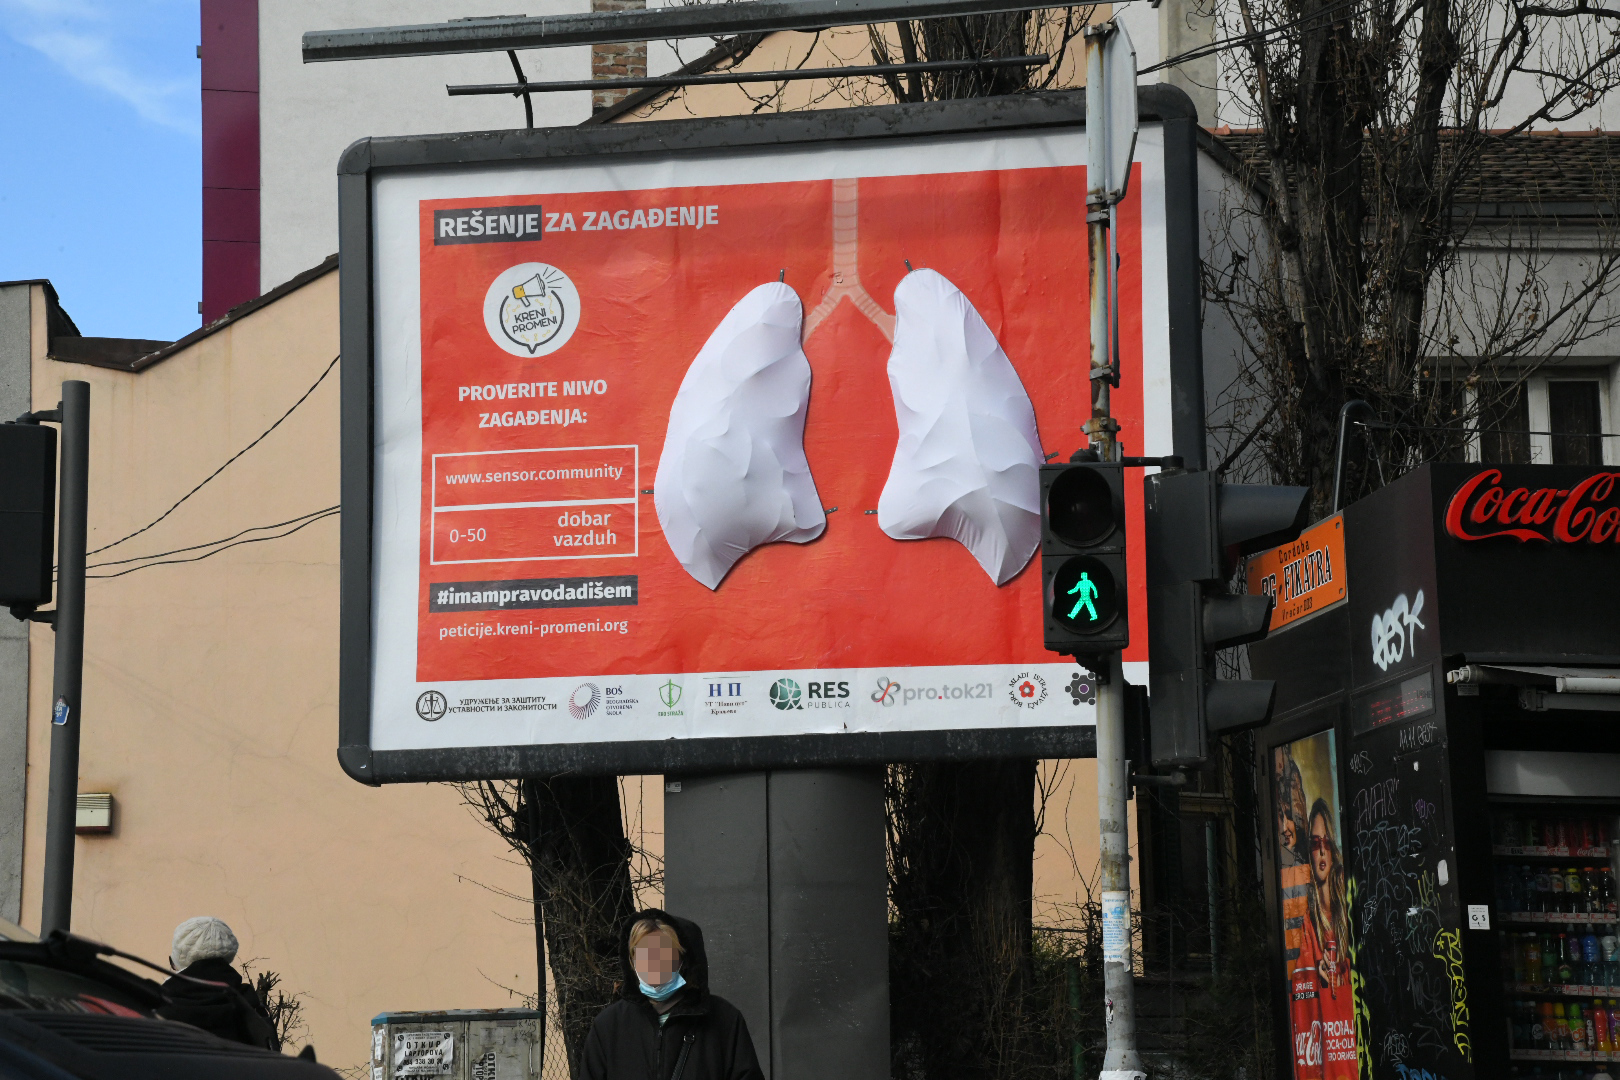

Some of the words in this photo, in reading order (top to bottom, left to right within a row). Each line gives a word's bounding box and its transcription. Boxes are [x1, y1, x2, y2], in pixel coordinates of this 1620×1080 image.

[439, 209, 539, 238] REŠENJE
[545, 212, 577, 232] ZA
[582, 205, 719, 230] ZAGAĐENJE
[514, 308, 547, 323] KRENI
[512, 315, 558, 335] PROMENI
[458, 381, 557, 401] PROVERITE
[563, 379, 607, 396] NIVO
[479, 409, 588, 428] ZAGAĐENJA:
[446, 463, 623, 484] www.sensor.community
[1446, 469, 1620, 543] Coca-Co
[558, 511, 611, 527] dobar
[450, 528, 486, 543] 0-50
[553, 529, 617, 547] vazduh
[1278, 540, 1310, 564] Cordoba
[437, 582, 632, 606] #imampravodadišem
[439, 619, 628, 640] peticije.kreni-promeni.org
[1008, 672, 1029, 688] MLADI
[605, 685, 623, 696] BOŠ
[808, 681, 850, 699] RES
[903, 683, 993, 706] pro.tok21
[448, 705, 496, 713] УСТАВНОСТИ
[504, 703, 557, 712] ЗАКОНИТОСТИ
[511, 696, 546, 704] ЗАШТИТУ
[807, 700, 851, 709] PUBLICA
[404, 1049, 443, 1057] LAPTOPOVA
[406, 1041, 441, 1050] OTKUP
[487, 1052, 496, 1080] OTK
